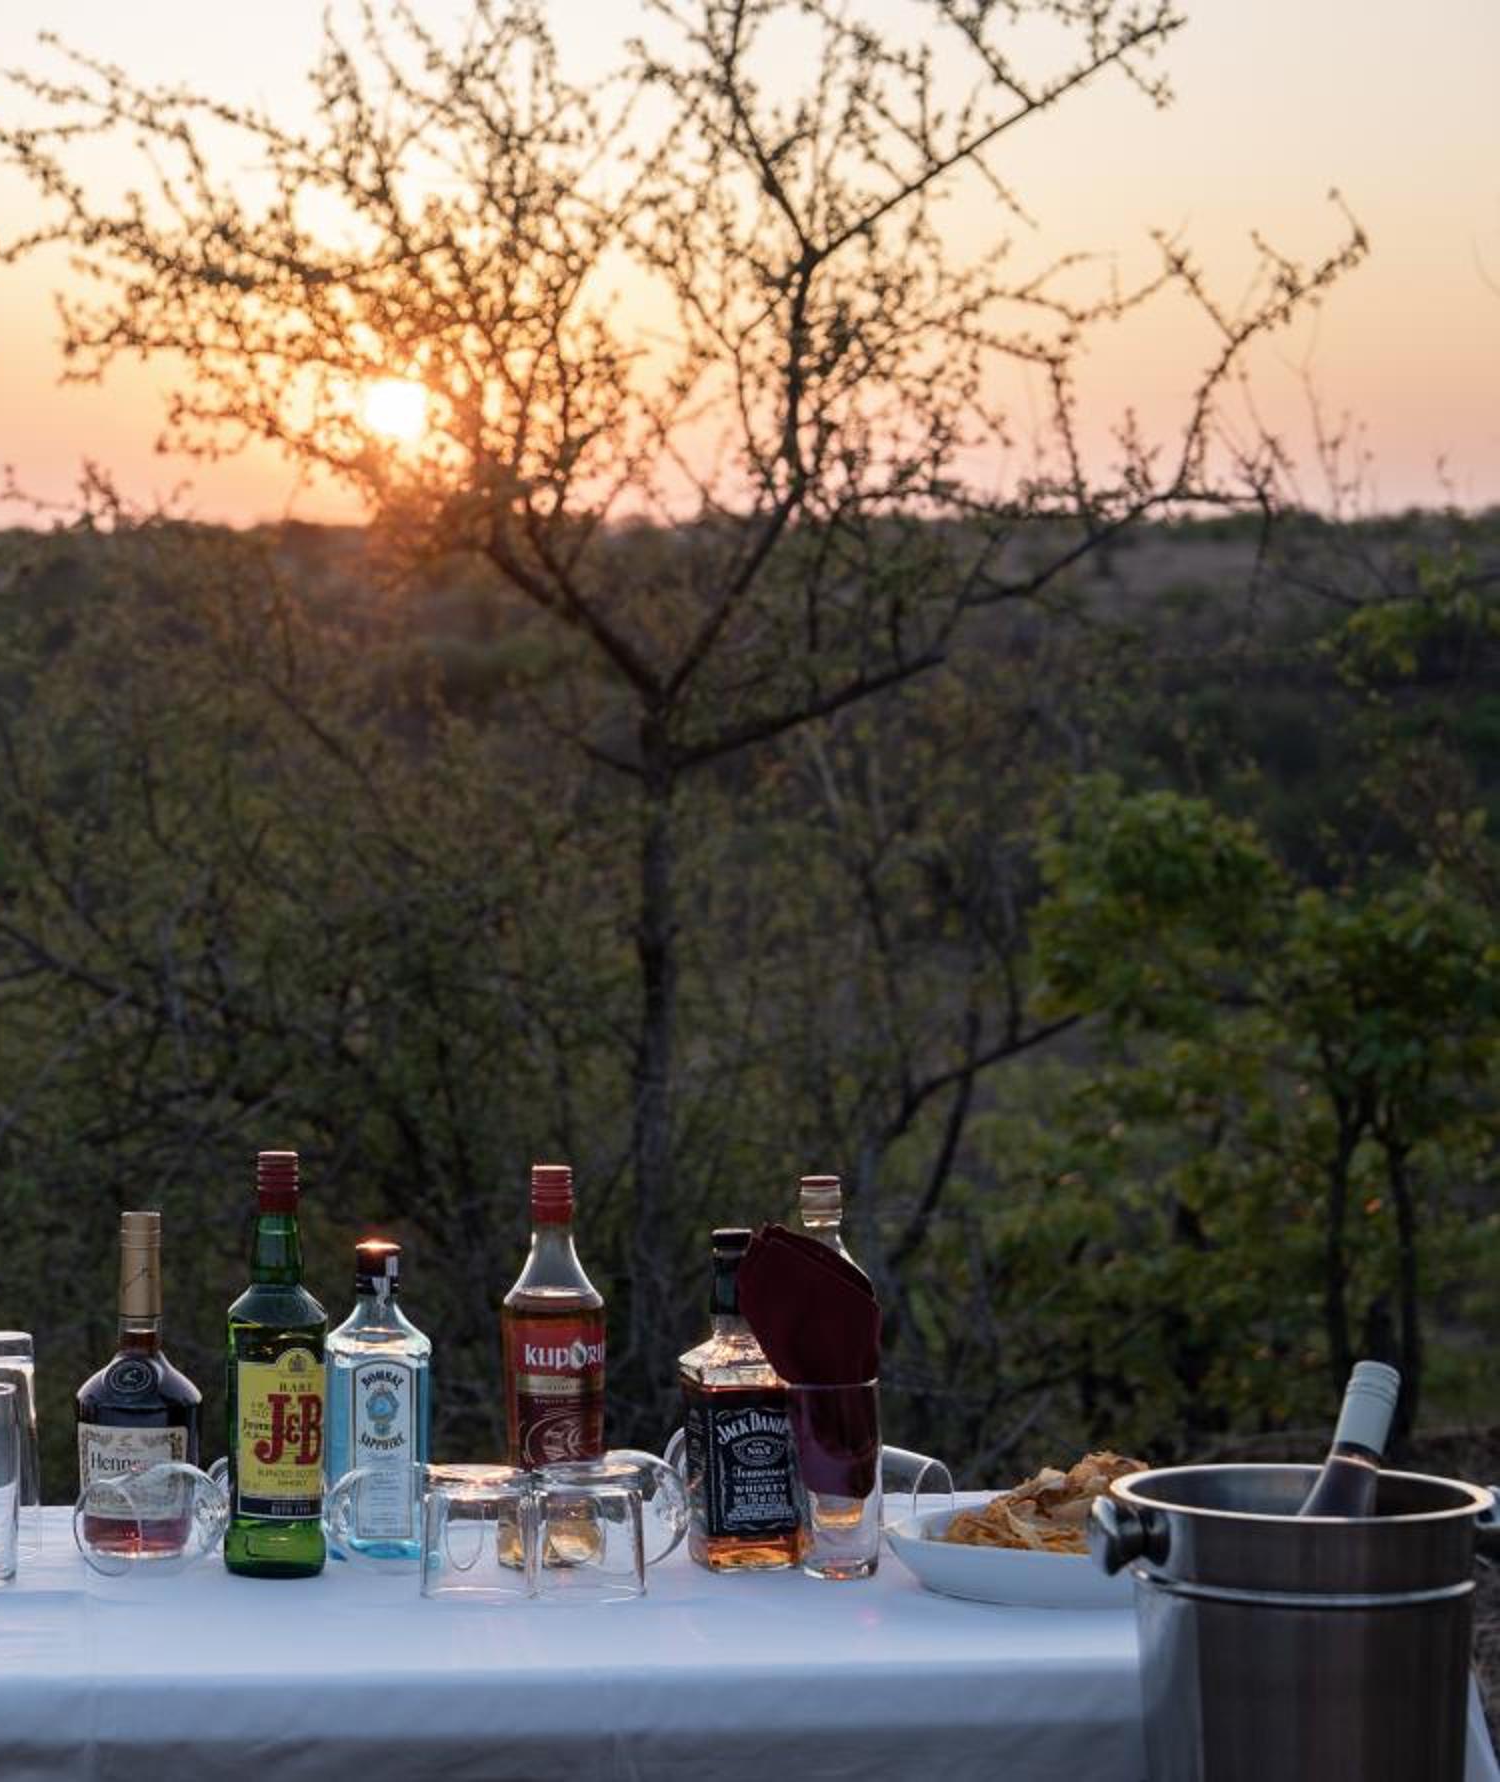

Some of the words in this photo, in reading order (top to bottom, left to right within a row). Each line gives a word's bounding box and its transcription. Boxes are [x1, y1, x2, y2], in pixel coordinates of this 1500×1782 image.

[361, 1370, 404, 1390] BOMBAY
[716, 1418, 749, 1445] JACK
[749, 1411, 789, 1434] DANIE
[733, 1483, 787, 1493] WHISKEY
